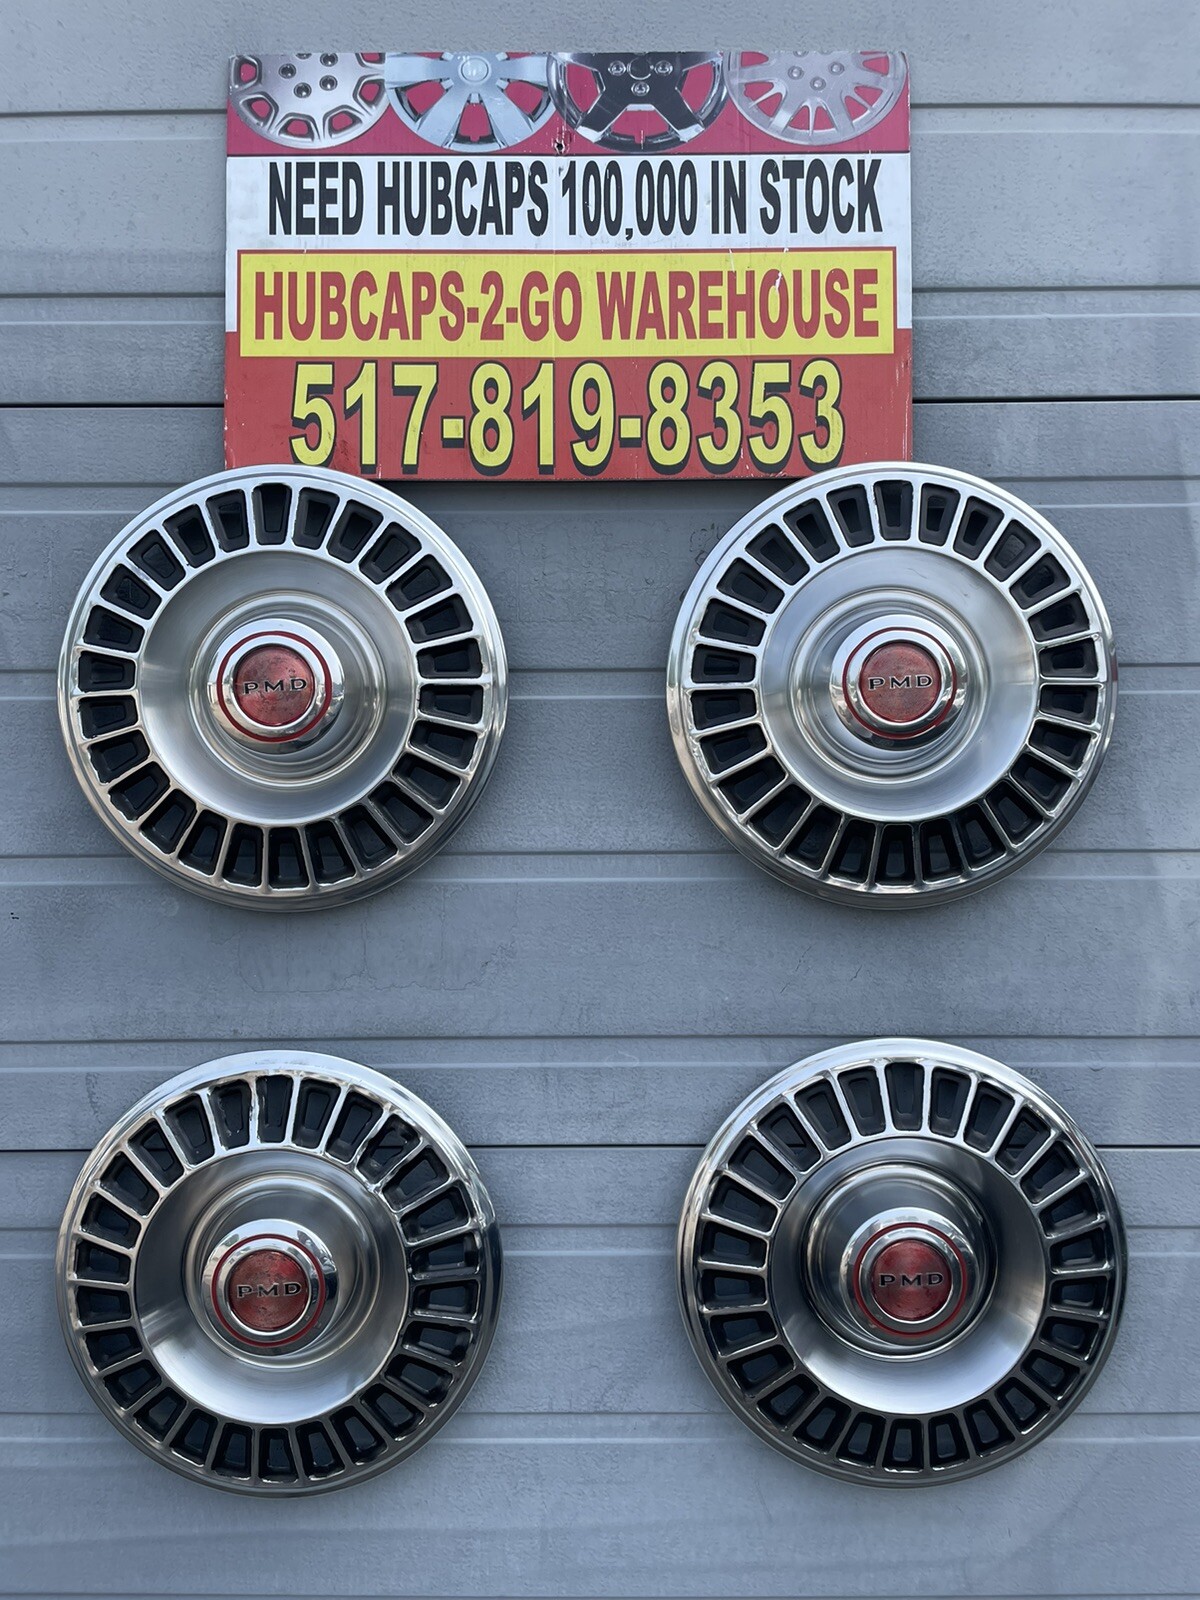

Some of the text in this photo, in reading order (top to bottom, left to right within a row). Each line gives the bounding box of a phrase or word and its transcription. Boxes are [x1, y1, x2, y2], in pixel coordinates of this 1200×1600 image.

[269, 158, 883, 241] NEED HUBCAPS 100,000 IN STOCK
[254, 268, 879, 342] HUBCAPS-2-GO WAREHOUSE
[289, 359, 845, 476] 517-819-8353
[243, 677, 307, 695] PMD
[868, 674, 933, 690] PMD
[878, 1272, 944, 1287] PMD
[237, 1282, 302, 1298] PMD
